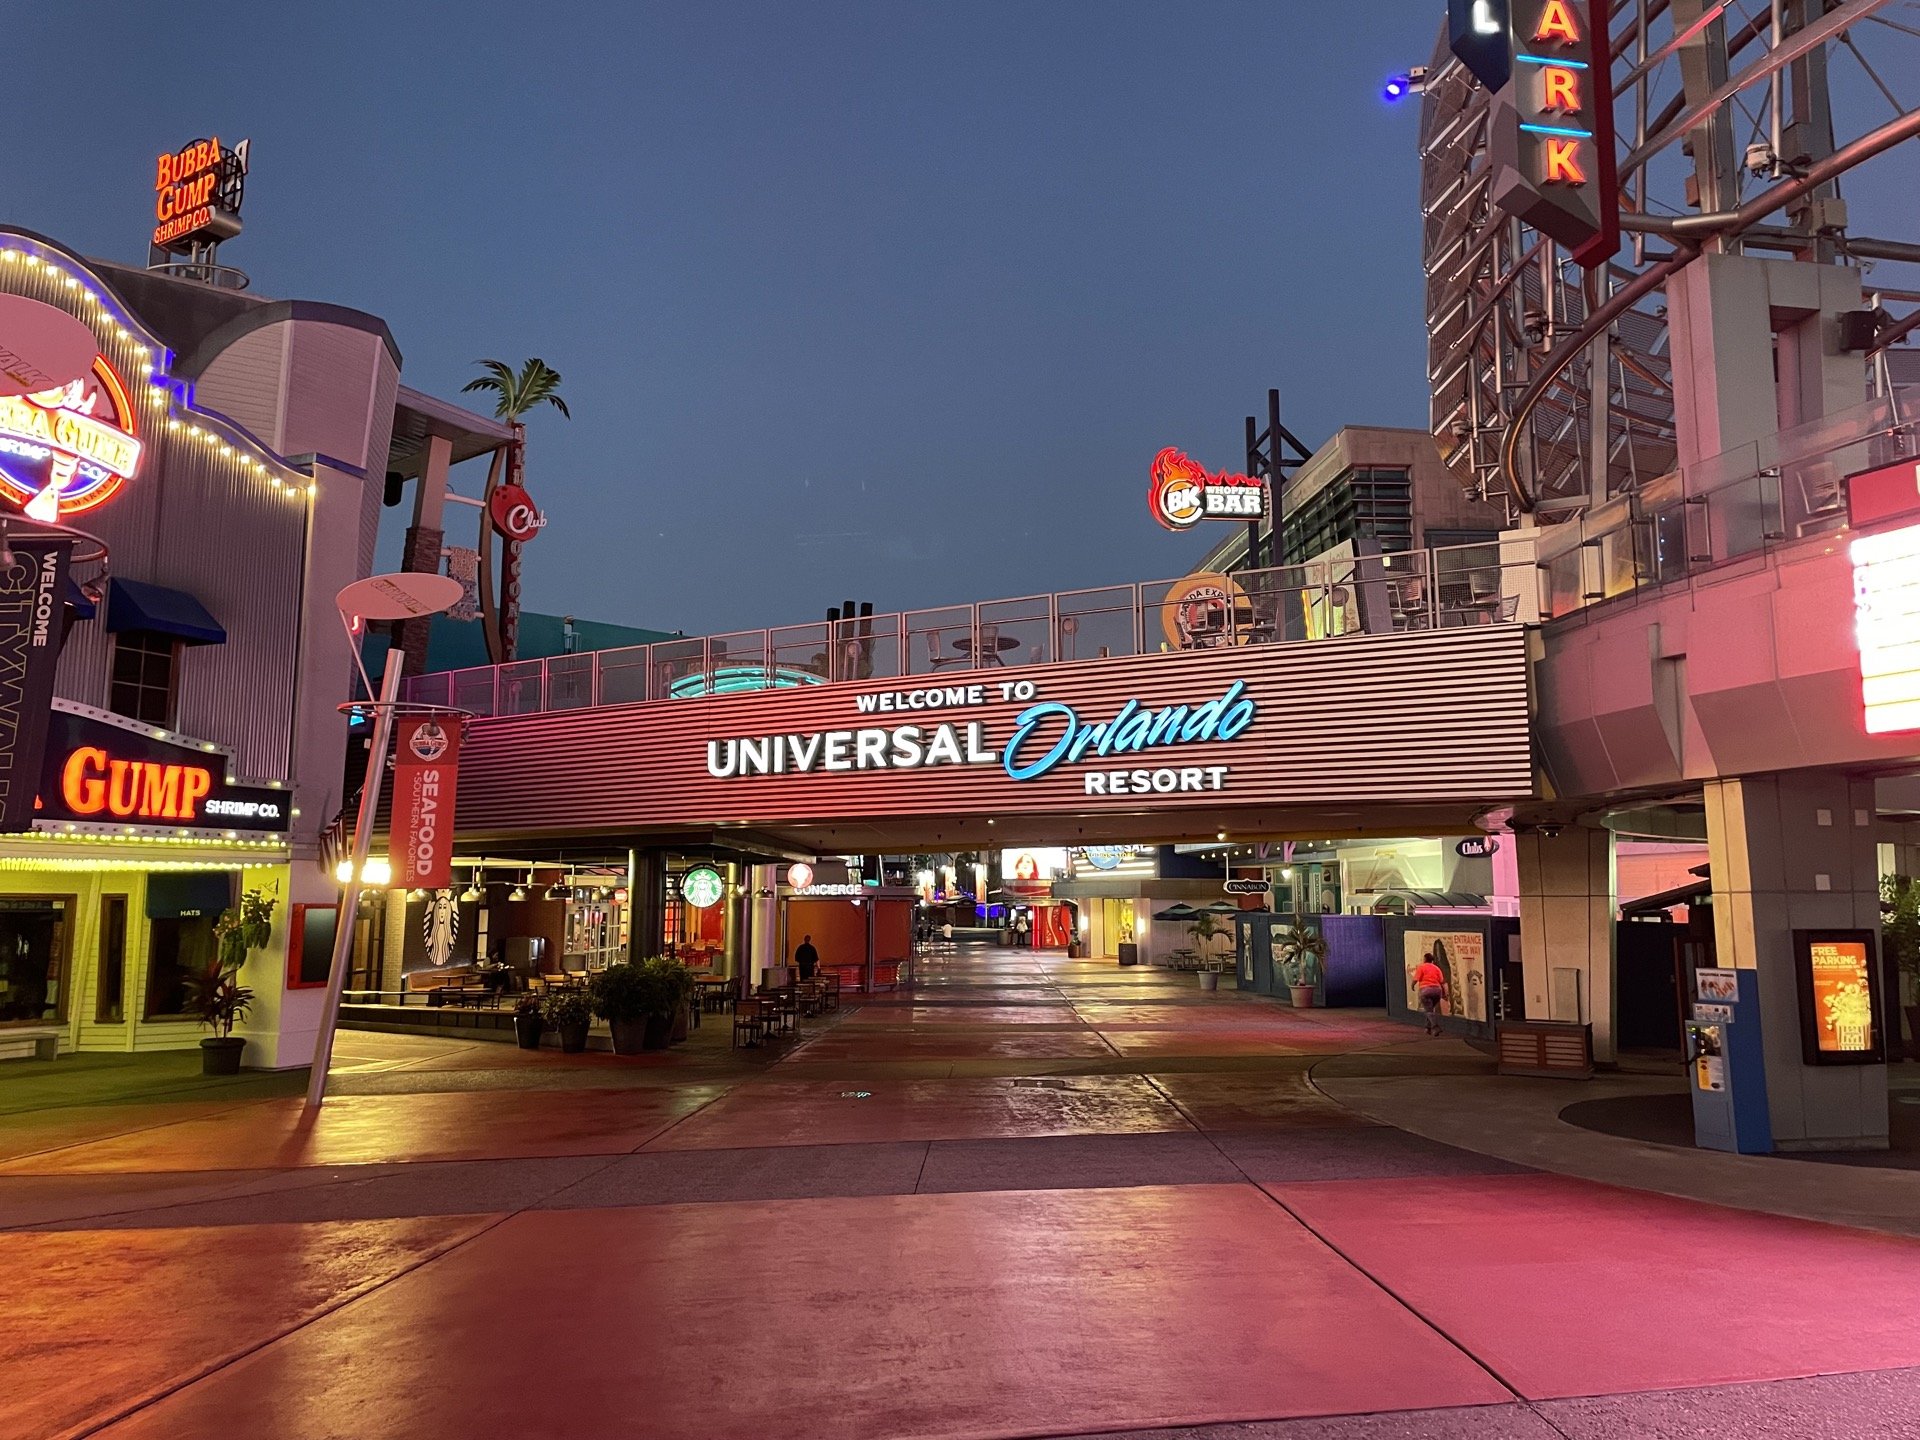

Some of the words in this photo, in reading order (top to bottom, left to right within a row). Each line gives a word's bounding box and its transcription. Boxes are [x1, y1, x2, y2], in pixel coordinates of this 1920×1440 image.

[156, 136, 221, 191] BUBBA
[157, 173, 216, 222] GUMP
[154, 214, 193, 244] SHRIMP
[193, 206, 210, 227] CO.
[1166, 486, 1201, 515] BK
[1205, 485, 1261, 496] WHOPPER
[1206, 495, 1262, 513] BAR
[508, 505, 548, 534] Club
[33, 551, 58, 647] WELCOME
[856, 685, 984, 713] WELCOME
[999, 680, 1037, 702] TO
[707, 721, 999, 777] UNIVERSAL
[1004, 680, 1257, 781] Orlando
[63, 746, 211, 819] GUMP
[205, 799, 259, 815] SHRIMP
[259, 802, 280, 817] CO.
[1084, 766, 1229, 795] RESORT
[410, 776, 422, 829] SOUTHERN
[416, 769, 440, 876] SEAFOOD
[406, 830, 418, 883] FAVORITES
[1462, 841, 1484, 855] Clubs
[793, 884, 863, 896] CONCIERGE
[180, 909, 201, 917] HATS
[1453, 935, 1482, 945] ENTRANCE
[1457, 945, 1470, 955] THIS
[1470, 946, 1482, 956] WAY
[1811, 946, 1839, 956] FREE
[1812, 955, 1857, 965] PARKING
